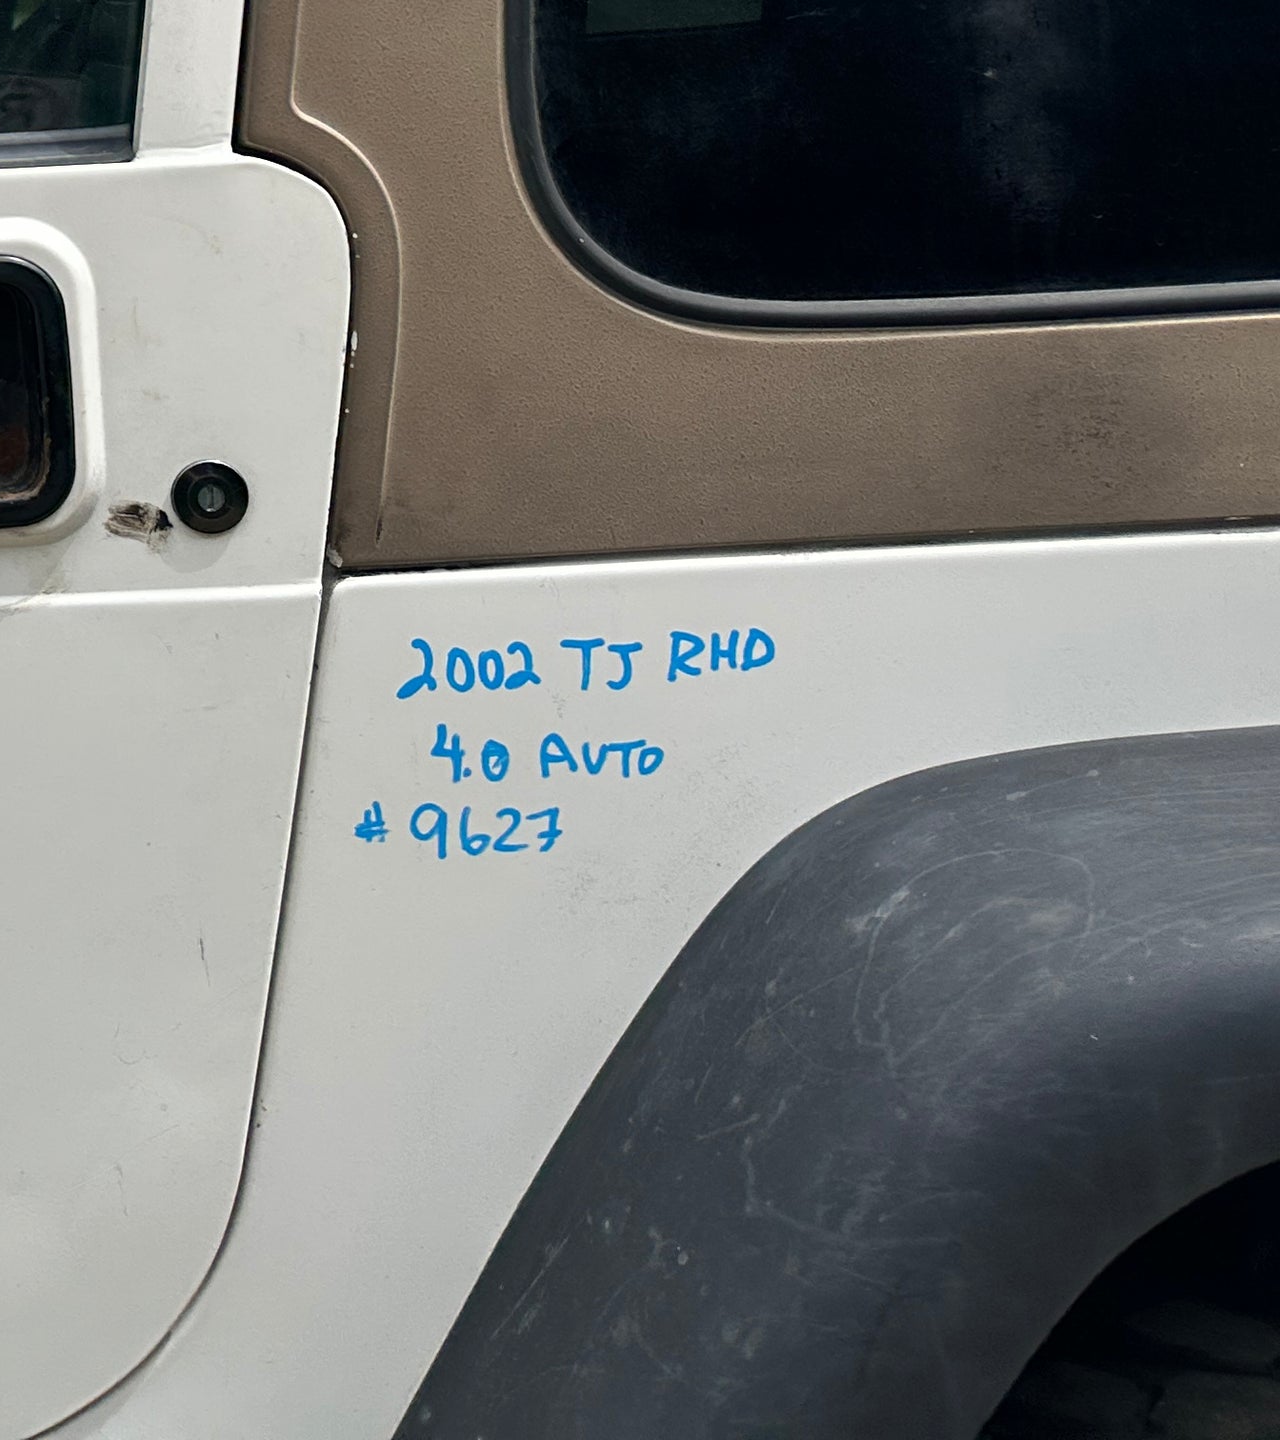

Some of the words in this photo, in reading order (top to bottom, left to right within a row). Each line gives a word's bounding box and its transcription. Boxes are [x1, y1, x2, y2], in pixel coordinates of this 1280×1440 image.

[395, 637, 542, 701] 2002
[559, 637, 644, 692] TJ
[666, 627, 777, 684] RHD
[430, 723, 511, 784] 4.0
[538, 731, 665, 780] AUTO
